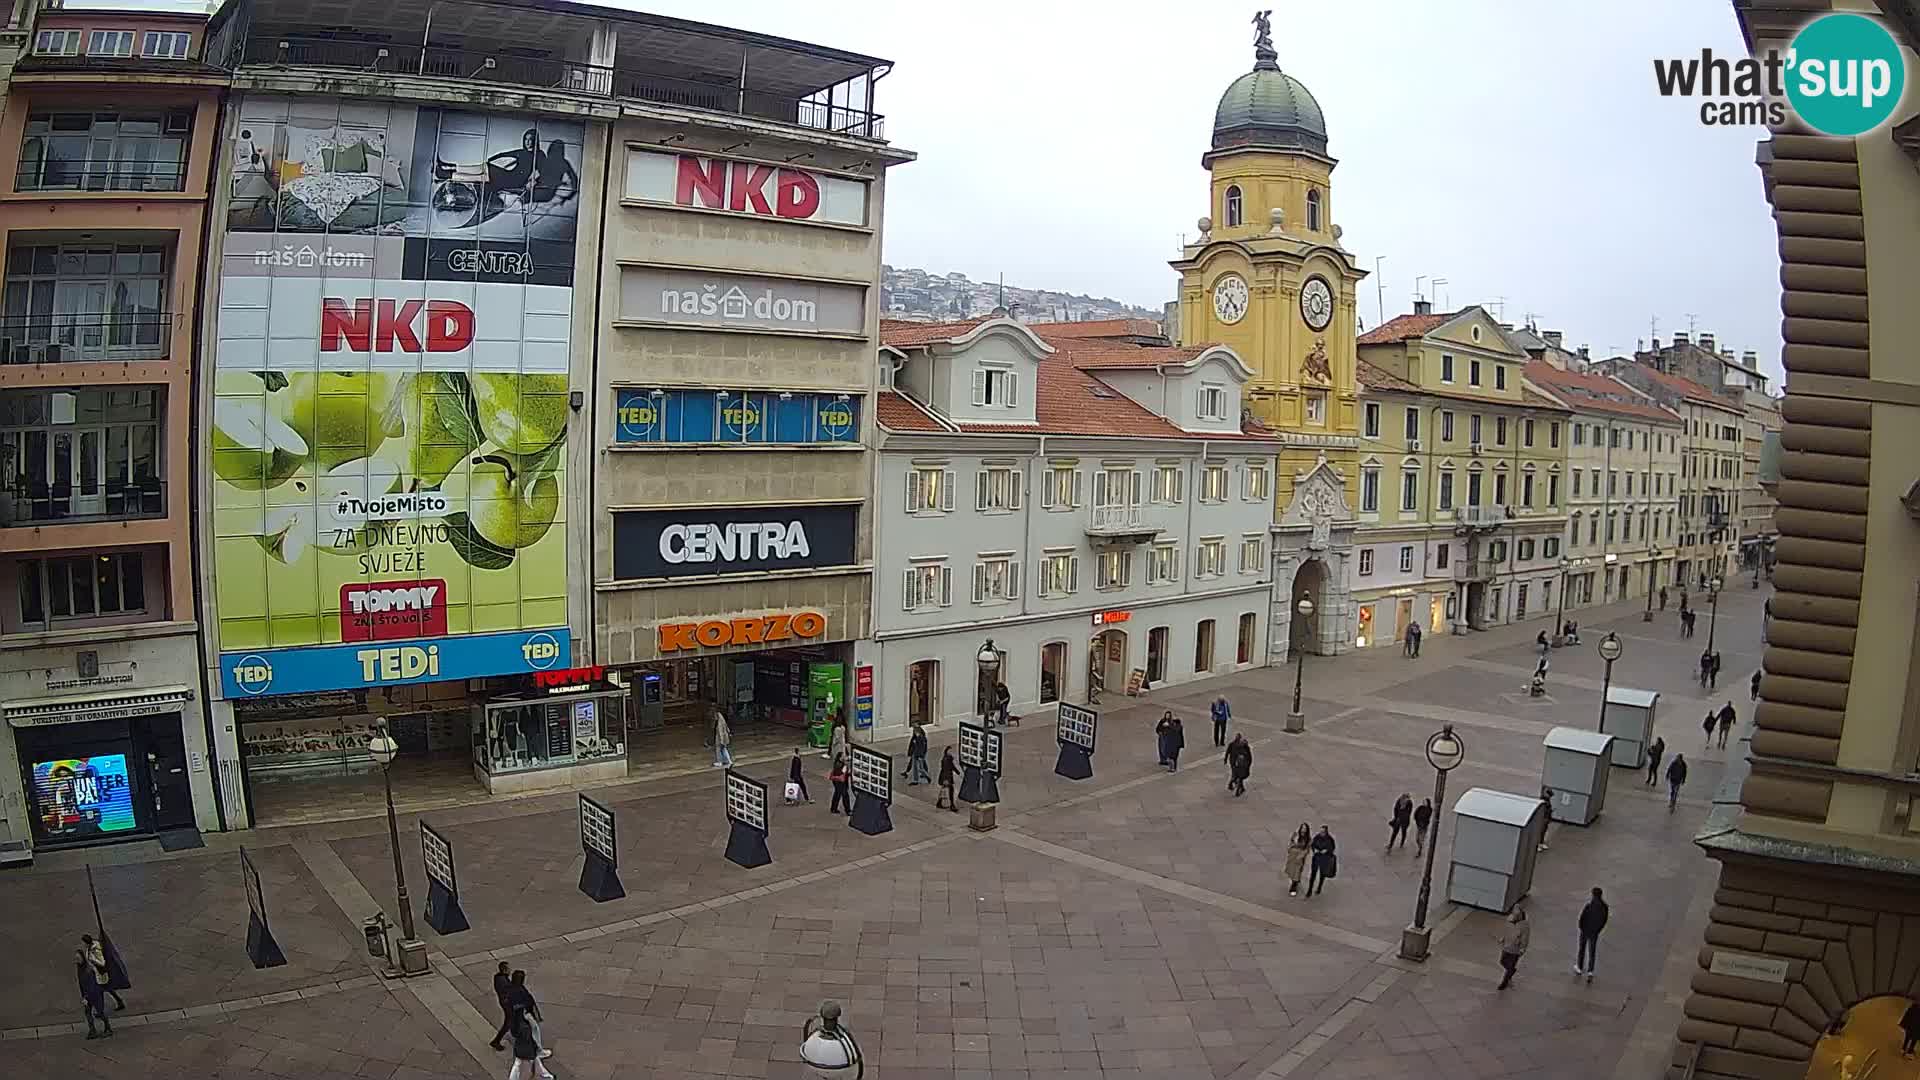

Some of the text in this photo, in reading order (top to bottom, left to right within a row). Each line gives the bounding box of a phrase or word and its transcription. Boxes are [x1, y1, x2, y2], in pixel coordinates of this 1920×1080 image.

[676, 155, 820, 218] NKD
[255, 246, 364, 267] naš dom
[448, 249, 534, 275] CENTRA
[662, 284, 816, 322] naš dom
[320, 297, 476, 352] NKD
[619, 408, 657, 425] TEDi
[723, 409, 759, 425] TEDi
[820, 411, 852, 426] TEDi
[338, 497, 446, 515] #TvojeMisto
[333, 524, 450, 548] ZA DNEVNO
[659, 520, 810, 564] CENTRA
[359, 548, 425, 574] SVJEŽE
[349, 586, 438, 614] TOMMY
[658, 612, 825, 652] KORZO
[358, 645, 439, 682] TEDi
[522, 642, 560, 660] TEDi
[233, 665, 273, 683] TEDi
